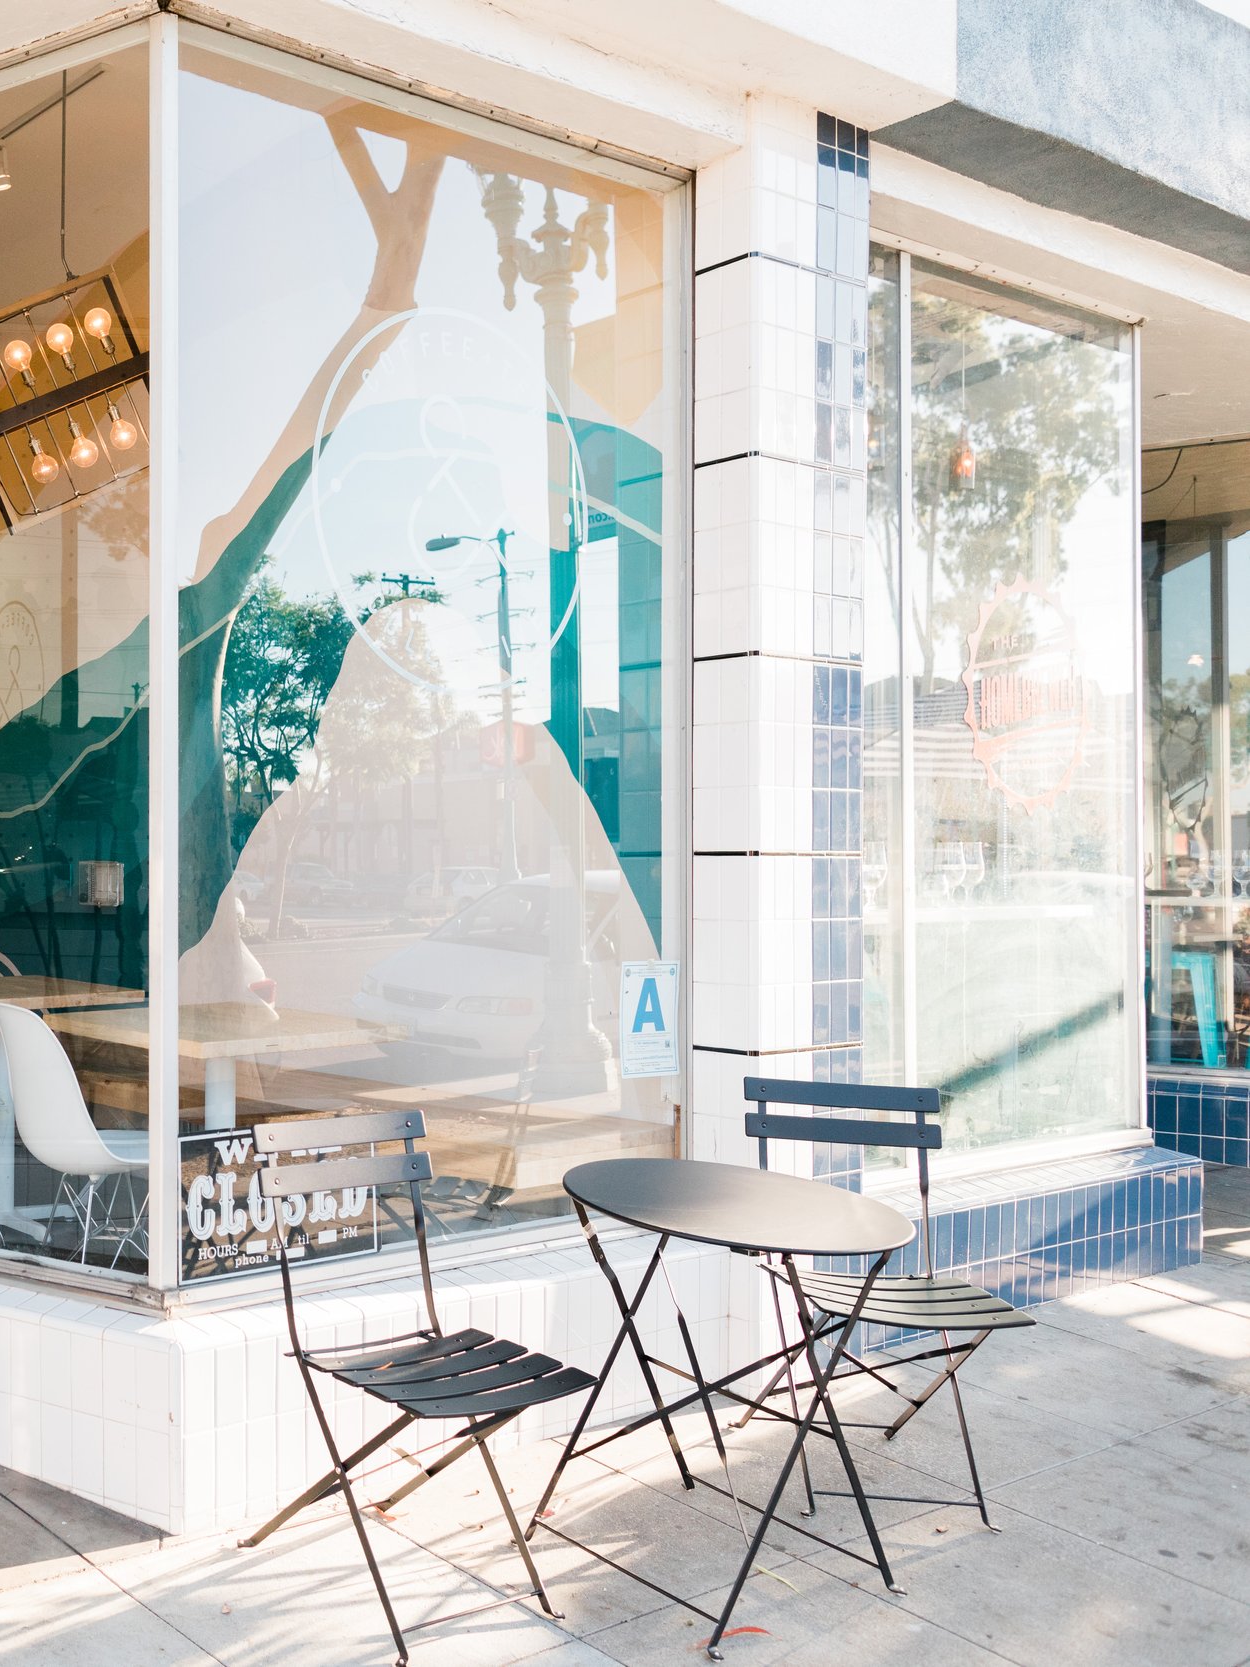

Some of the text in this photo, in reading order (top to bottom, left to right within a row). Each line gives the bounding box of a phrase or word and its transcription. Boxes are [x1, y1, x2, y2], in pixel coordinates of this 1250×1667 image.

[991, 634, 1018, 650] THE
[632, 977, 666, 1033] A
[197, 1243, 239, 1261] HOURS
[342, 1226, 358, 1239] PM
[234, 1253, 269, 1269] phone
